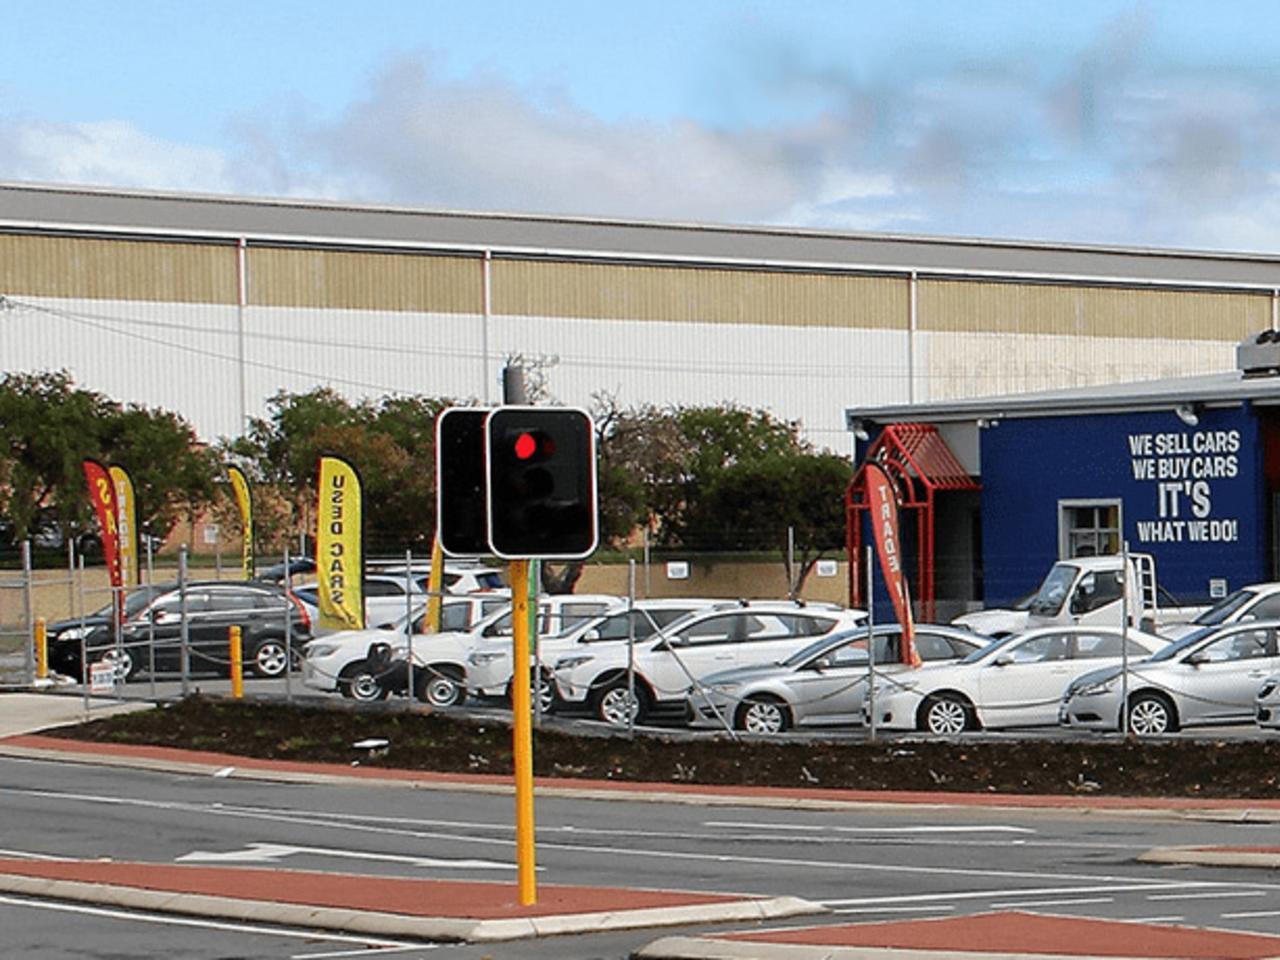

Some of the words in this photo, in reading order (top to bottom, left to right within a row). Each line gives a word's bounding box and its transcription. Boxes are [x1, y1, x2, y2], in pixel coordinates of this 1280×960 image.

[1128, 434, 1153, 456] WE
[1155, 433, 1191, 455] SELL
[1193, 430, 1240, 453] CARS
[1132, 458, 1155, 479] WE
[1158, 458, 1190, 479] BUY
[1192, 455, 1238, 478] CARS
[1158, 481, 1211, 518] IT'S
[1137, 521, 1185, 542] WHAT
[1187, 521, 1208, 541] WE
[1210, 519, 1238, 541] DO!
